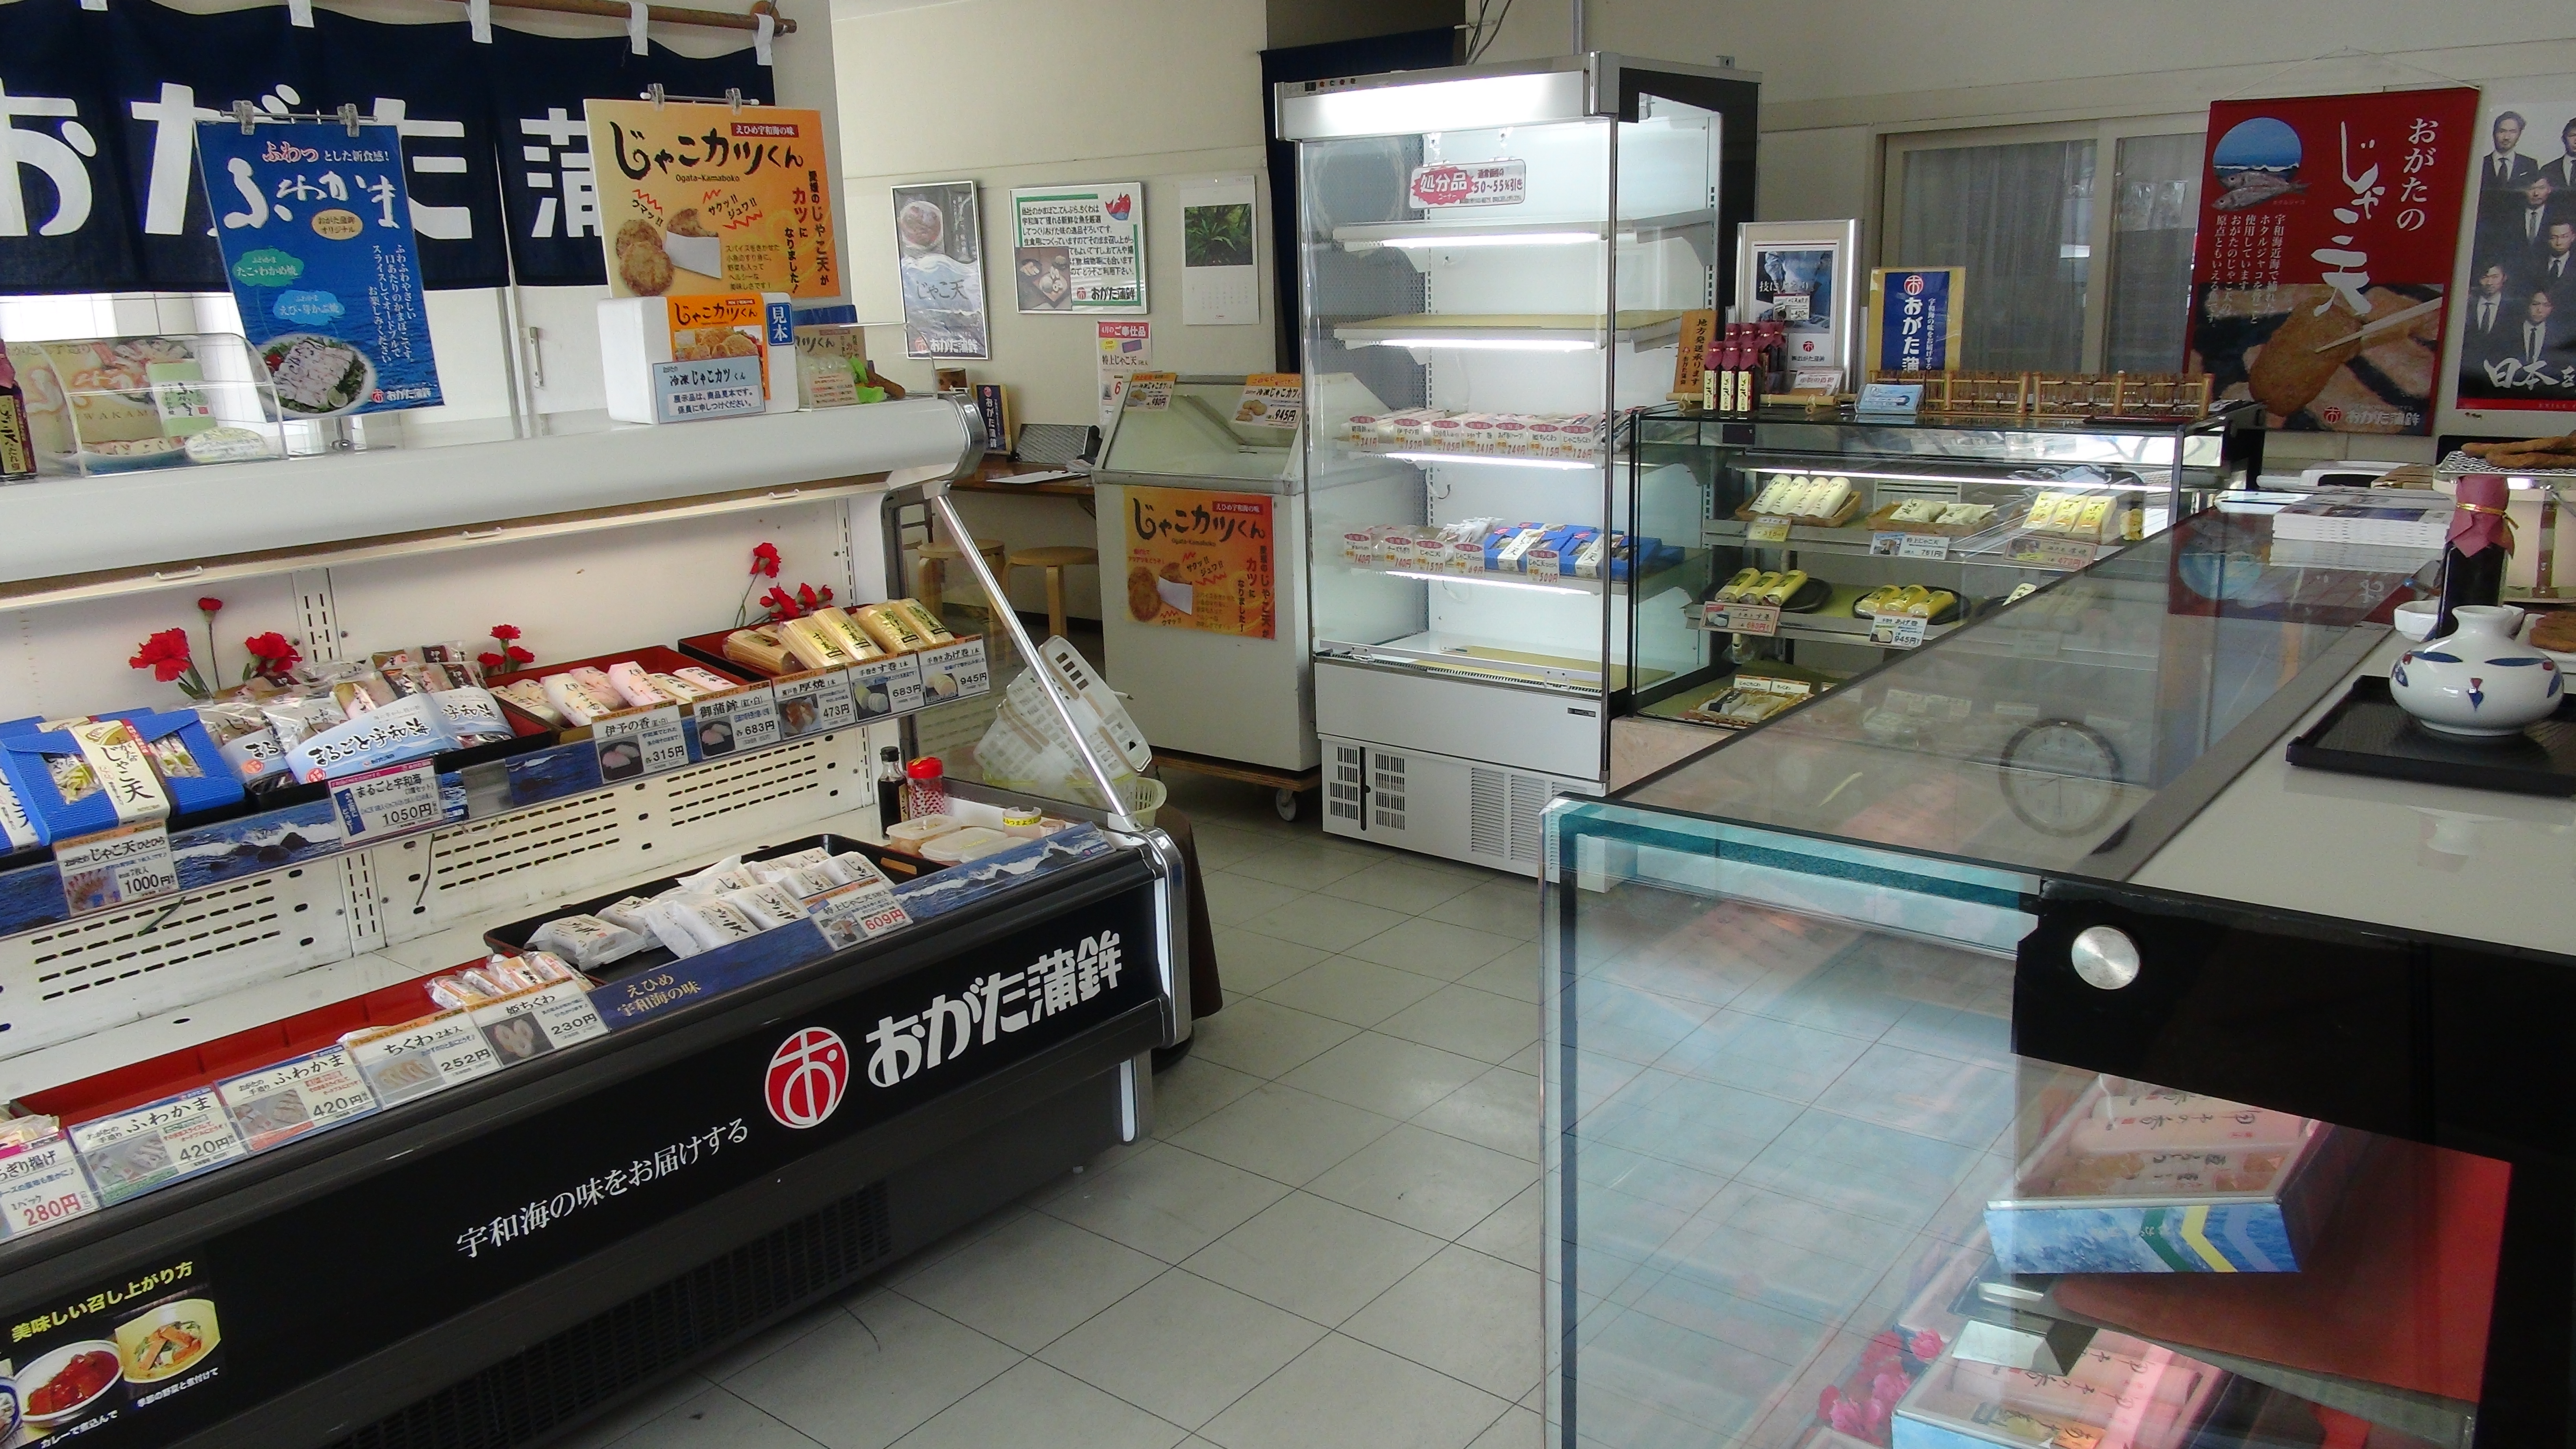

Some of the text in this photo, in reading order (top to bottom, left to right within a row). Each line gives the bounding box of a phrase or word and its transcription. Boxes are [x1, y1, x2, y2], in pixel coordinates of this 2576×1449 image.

[610, 121, 804, 180] じゃこカツくん
[675, 174, 740, 183] Ogata-Kamaboko
[1421, 173, 1468, 193] 処分品
[2396, 118, 2439, 231] おがたの
[223, 157, 401, 230] ふわかま
[321, 226, 356, 234] オリジナル
[2311, 121, 2385, 317] じゃこ天
[2239, 215, 2257, 290] 使用しています
[396, 244, 416, 320] ふわふわやさしい
[916, 279, 969, 301] じゃこ天
[372, 245, 401, 359] スライスしてオードブルで
[675, 302, 758, 326] じゃこカツくん
[771, 305, 788, 342] 見本
[1691, 319, 1708, 386] 地方発送承ります
[1275, 409, 1296, 421] 945円
[1133, 498, 1265, 543] じゃこカツくん
[892, 685, 922, 698] 683円
[960, 672, 987, 686] 945円
[699, 699, 738, 719] 御蒲鉾
[823, 703, 850, 718] 473円
[605, 716, 650, 737] 伊予の香
[307, 717, 431, 766] まるごと宇和海
[101, 746, 155, 802] じゃこ天
[355, 773, 422, 798] まるごと宇和海
[382, 802, 432, 825] 1050円
[124, 874, 172, 895] 1000円
[864, 908, 906, 930] 609円
[627, 973, 675, 997] えひめ
[505, 995, 555, 1015] 姫ちくわ
[617, 980, 702, 1017] 宇和海の味
[865, 928, 1125, 1088] おがた蒲鉾
[551, 1012, 598, 1036] 230円
[384, 1025, 463, 1056] ちくわ 2本入
[274, 1054, 346, 1086] ふわかま
[441, 1048, 491, 1073] 252円
[126, 1097, 210, 1134] ふわかま
[313, 1093, 362, 1117] 420円
[179, 1137, 229, 1162] 420円
[455, 1117, 749, 1260] 宇和海の味をお届けする
[22, 1193, 82, 1227] 280円
[11, 1260, 194, 1343] 美味しい召し上がり方
